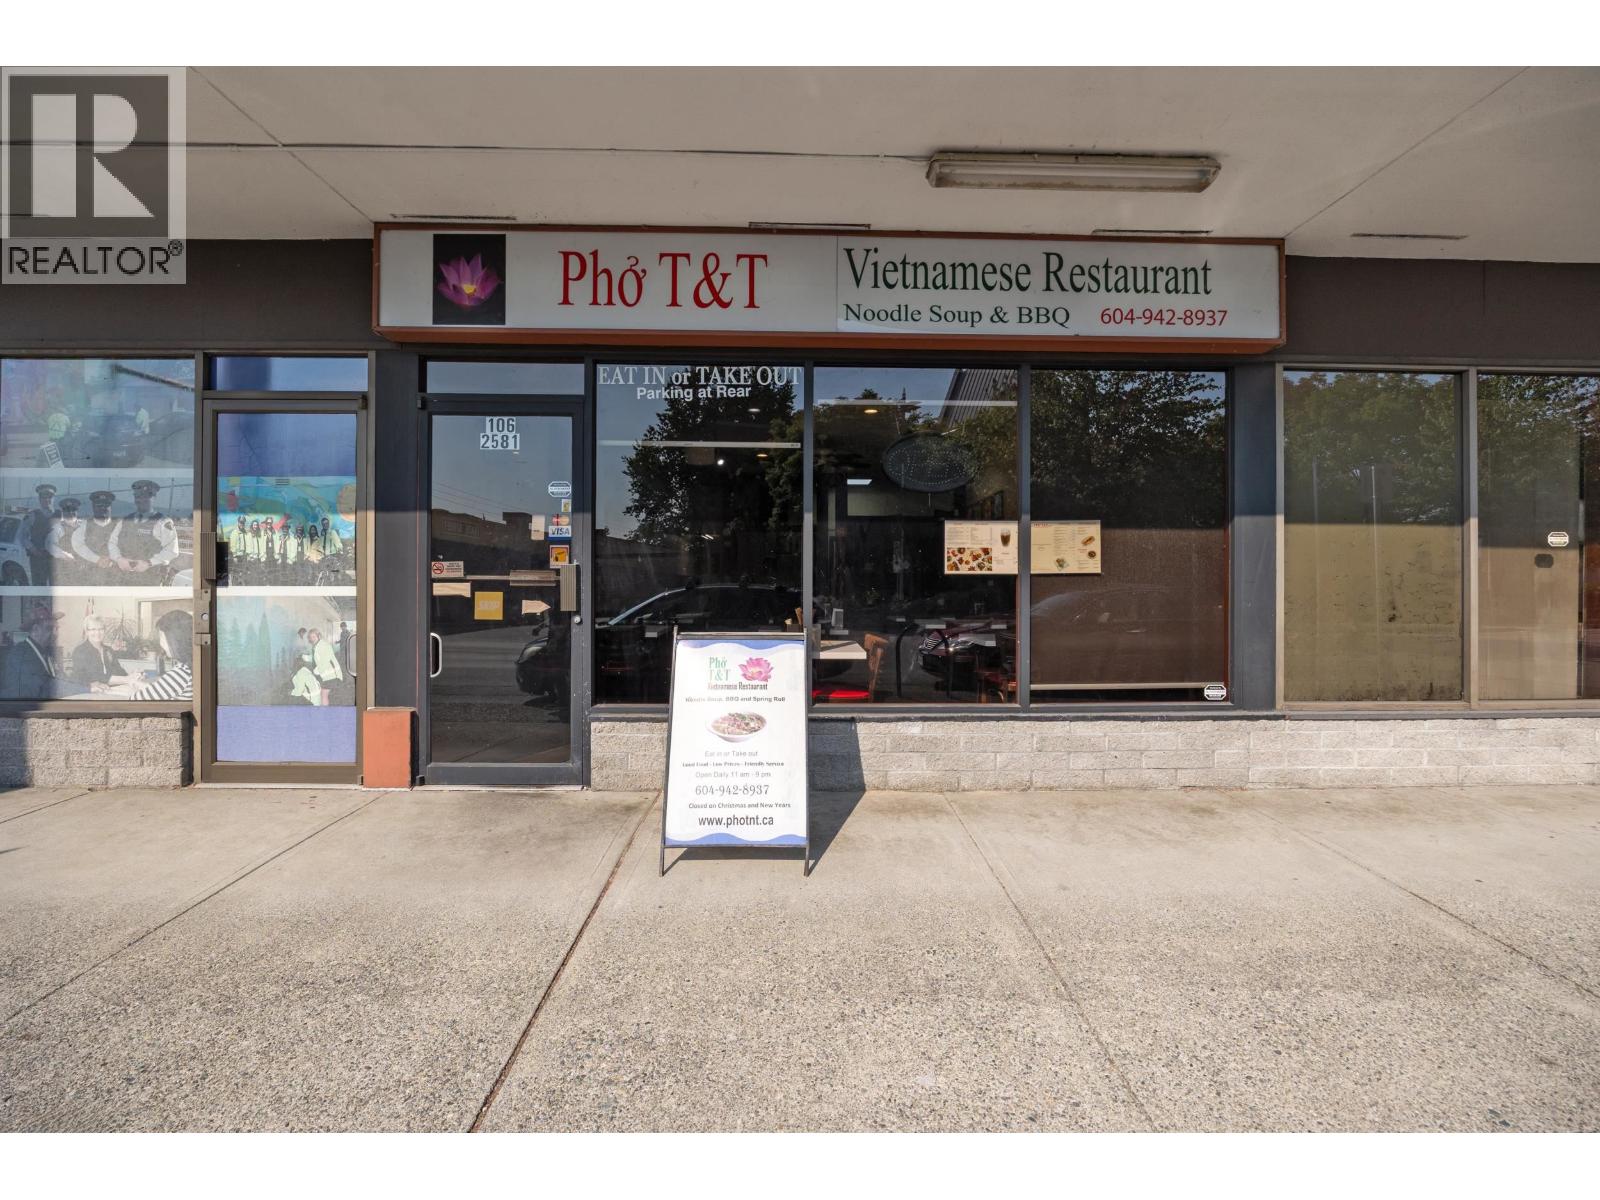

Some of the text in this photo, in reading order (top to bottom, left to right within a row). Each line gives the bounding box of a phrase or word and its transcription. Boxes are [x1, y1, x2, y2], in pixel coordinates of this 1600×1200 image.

[843, 247, 1212, 295] Vietnamese Restaurant
[557, 249, 768, 309] Phở T&T
[843, 303, 1228, 328] Noodle Soup & BBQ 604-942-8937
[598, 366, 803, 385] EAT IN or TAKE OUT
[637, 385, 752, 401] Parking at Rear
[488, 417, 515, 433] 106
[481, 434, 519, 449] 2581
[551, 527, 570, 536] VISA
[709, 668, 731, 681] T&T
[739, 681, 768, 690] Restaurant
[695, 771, 712, 779] Open
[714, 771, 729, 779] Daily
[695, 784, 770, 796] 604-942-8937
[698, 814, 774, 828] www.photnt.ca
